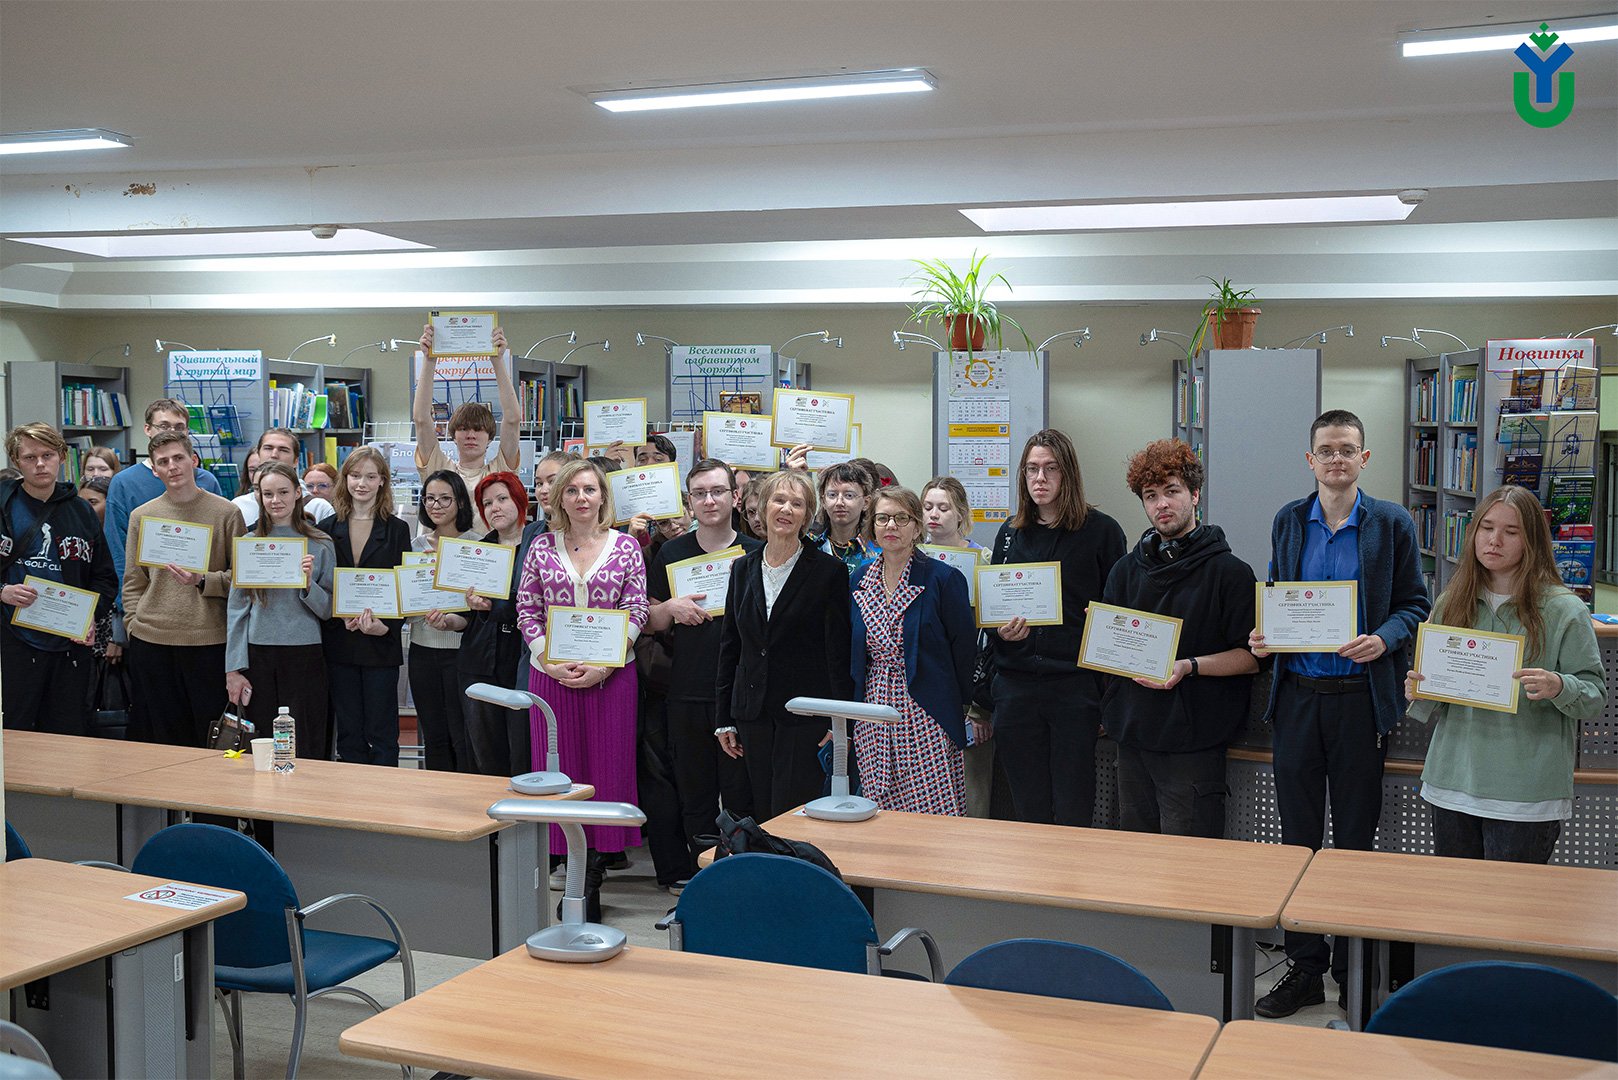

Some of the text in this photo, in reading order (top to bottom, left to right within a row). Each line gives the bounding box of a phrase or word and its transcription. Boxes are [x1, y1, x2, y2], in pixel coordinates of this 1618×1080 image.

[1498, 347, 1585, 360] Новинки
[173, 354, 258, 364] Удивительный
[684, 356, 760, 366] алфавитном
[184, 367, 230, 377] хрупкий
[699, 366, 745, 376] порядке
